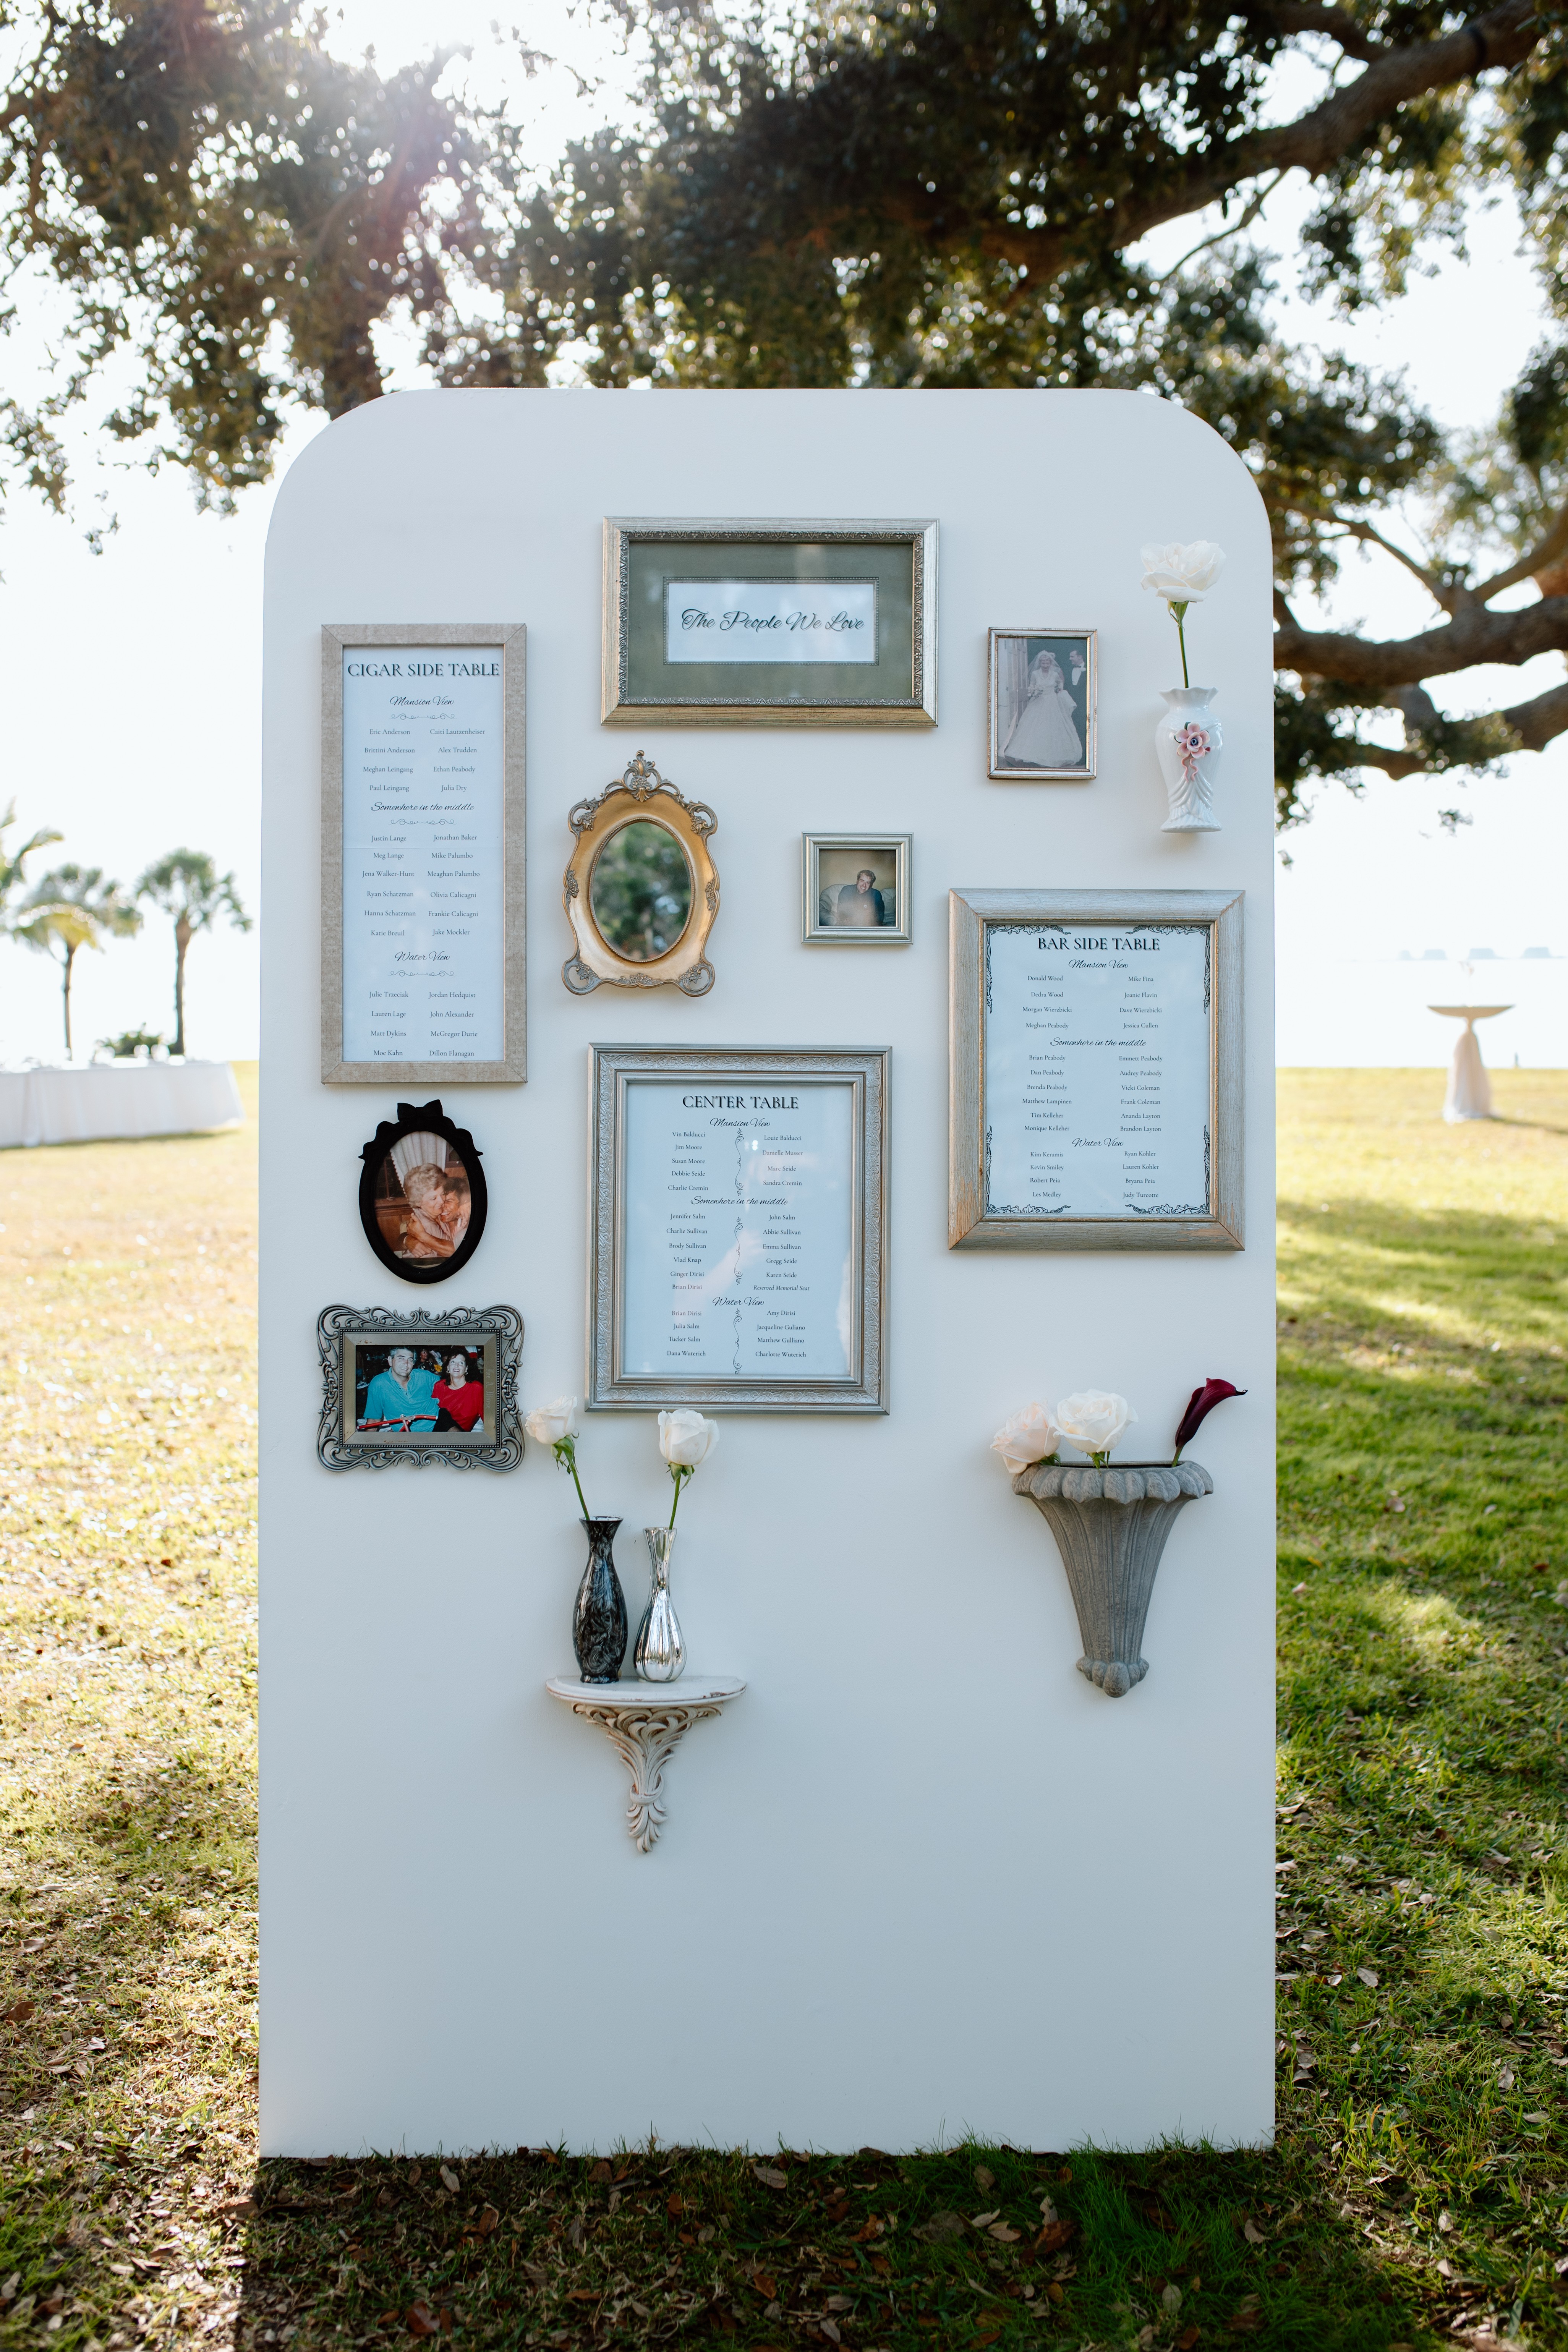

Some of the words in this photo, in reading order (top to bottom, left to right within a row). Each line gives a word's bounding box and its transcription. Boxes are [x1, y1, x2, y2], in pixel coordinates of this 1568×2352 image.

[681, 609, 716, 630] The
[719, 611, 782, 633] People
[785, 612, 822, 631] We
[825, 611, 864, 632] Love
[348, 664, 403, 677] CIGAR
[408, 664, 444, 676] SIDE
[448, 664, 500, 676] TABLE
[389, 697, 431, 706] Mansion
[432, 696, 454, 705] View
[370, 802, 418, 811] Somewhere
[427, 870, 453, 878] Meaghan
[1037, 938, 1070, 950] BAR
[1074, 938, 1108, 950] SIDE
[1111, 938, 1160, 950] TABLE
[395, 951, 427, 961] Water
[428, 951, 450, 961] View
[1068, 959, 1107, 968] Mansion
[1108, 959, 1129, 969] View
[1050, 1037, 1094, 1046] Somewhere
[449, 1050, 474, 1058] Flanagan
[682, 1096, 747, 1108] CENTER
[750, 1097, 799, 1109] TABLE
[709, 1118, 749, 1127] Mansion
[750, 1118, 771, 1127] View
[1072, 1138, 1102, 1147] Water
[1103, 1137, 1124, 1147] View
[690, 1196, 735, 1205] Somewhere
[712, 1297, 743, 1306] Water
[744, 1297, 764, 1306] View
